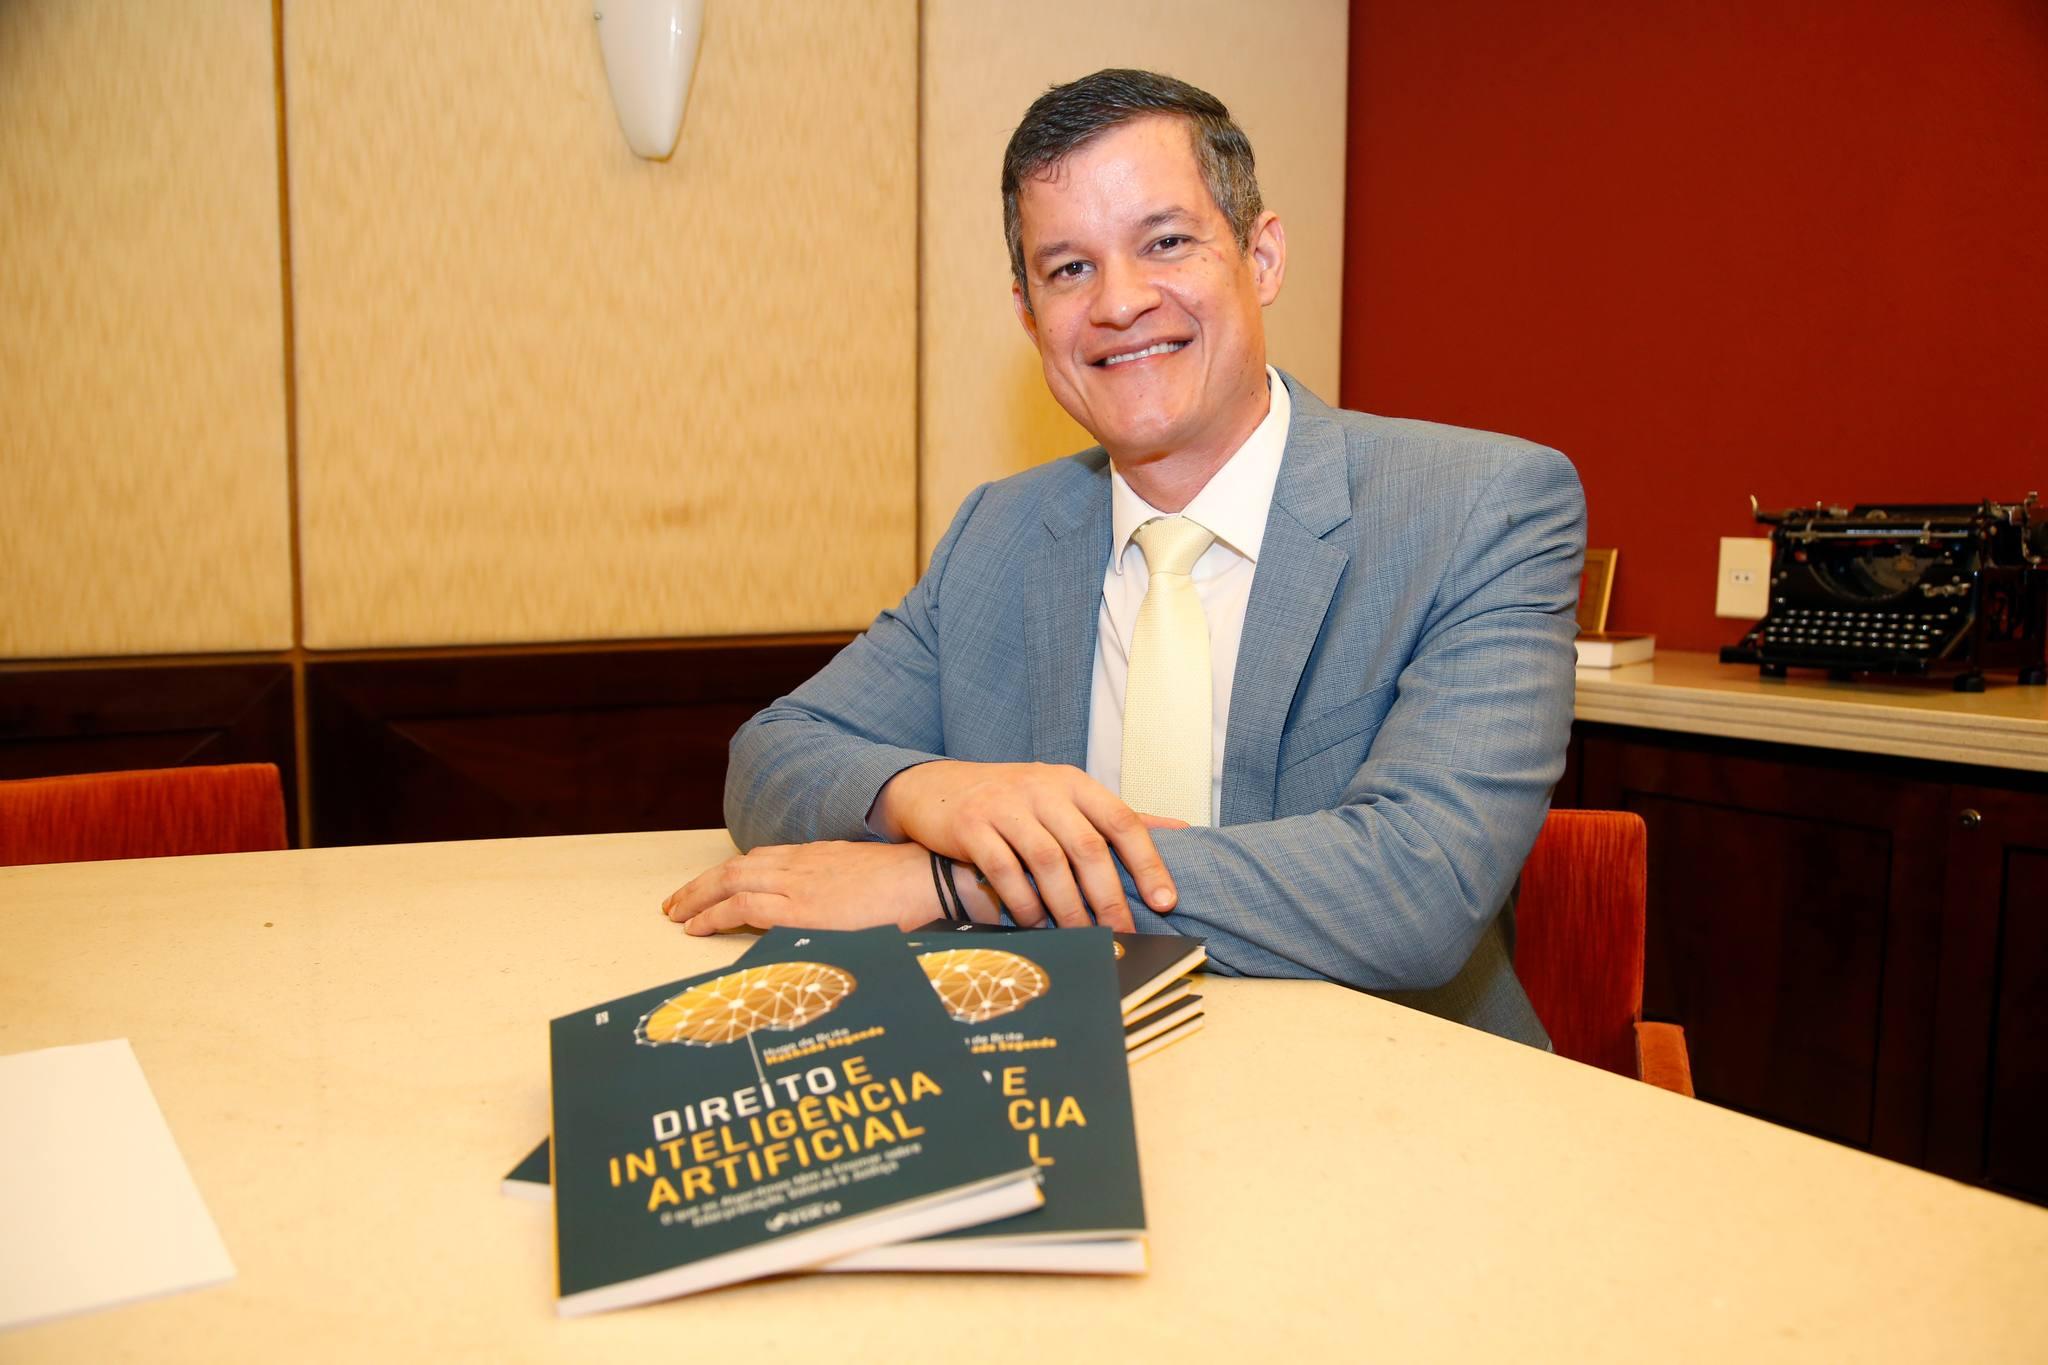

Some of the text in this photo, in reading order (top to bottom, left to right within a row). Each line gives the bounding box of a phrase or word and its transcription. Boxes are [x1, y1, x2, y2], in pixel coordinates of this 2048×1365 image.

[815, 1028, 850, 1043] Brito
[827, 1026, 885, 1048] Segundo
[998, 1037, 1057, 1052] Segundo
[1002, 1066, 1027, 1097] E
[652, 1056, 872, 1142] DIREITO E
[608, 1071, 943, 1188] INTELIGÊNCIA
[646, 1110, 926, 1212] ARTIFICIAL
